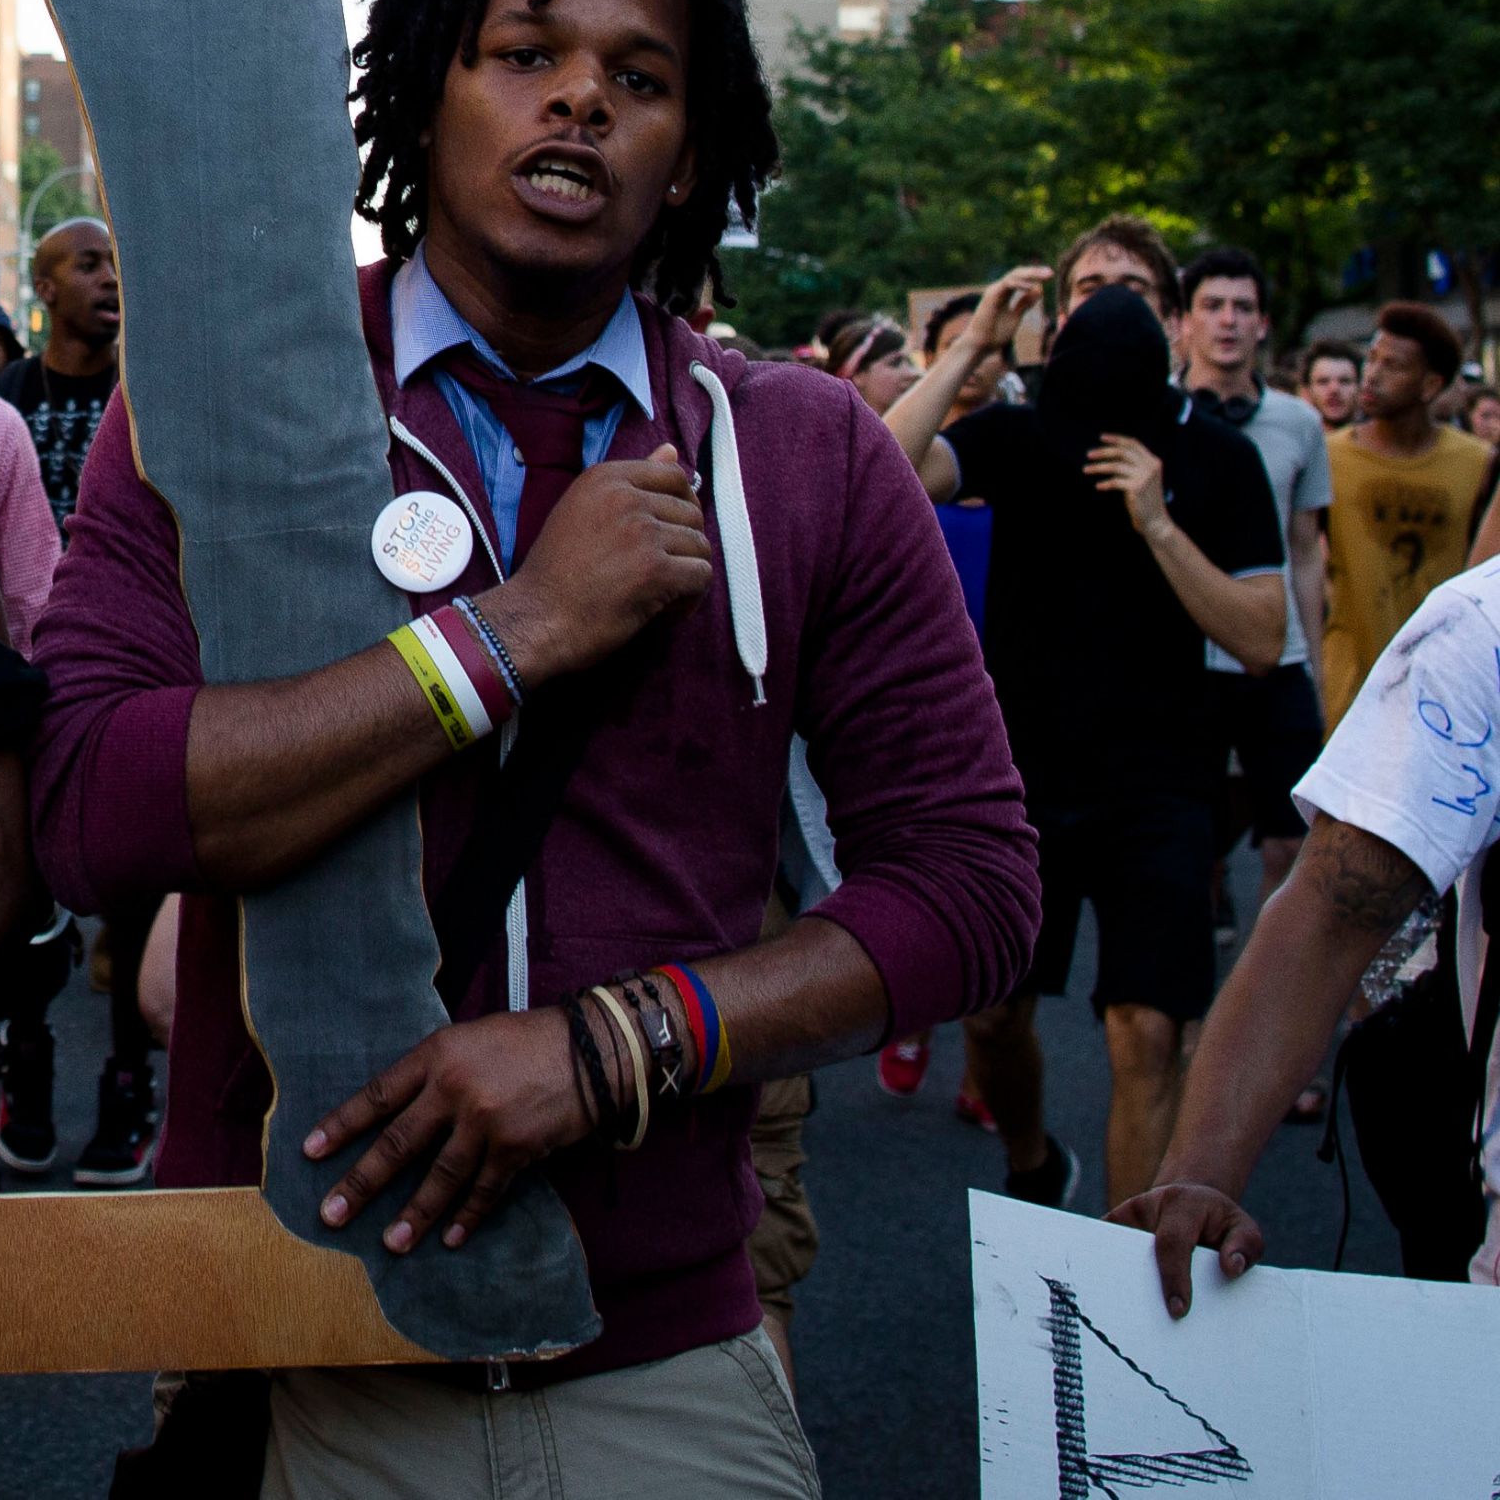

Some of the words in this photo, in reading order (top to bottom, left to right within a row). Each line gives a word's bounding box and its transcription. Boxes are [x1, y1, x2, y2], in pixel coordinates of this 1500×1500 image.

[382, 501, 421, 558] STOP
[396, 508, 435, 566] SHOOTING
[405, 513, 447, 573] START
[419, 524, 461, 582] LIVING
